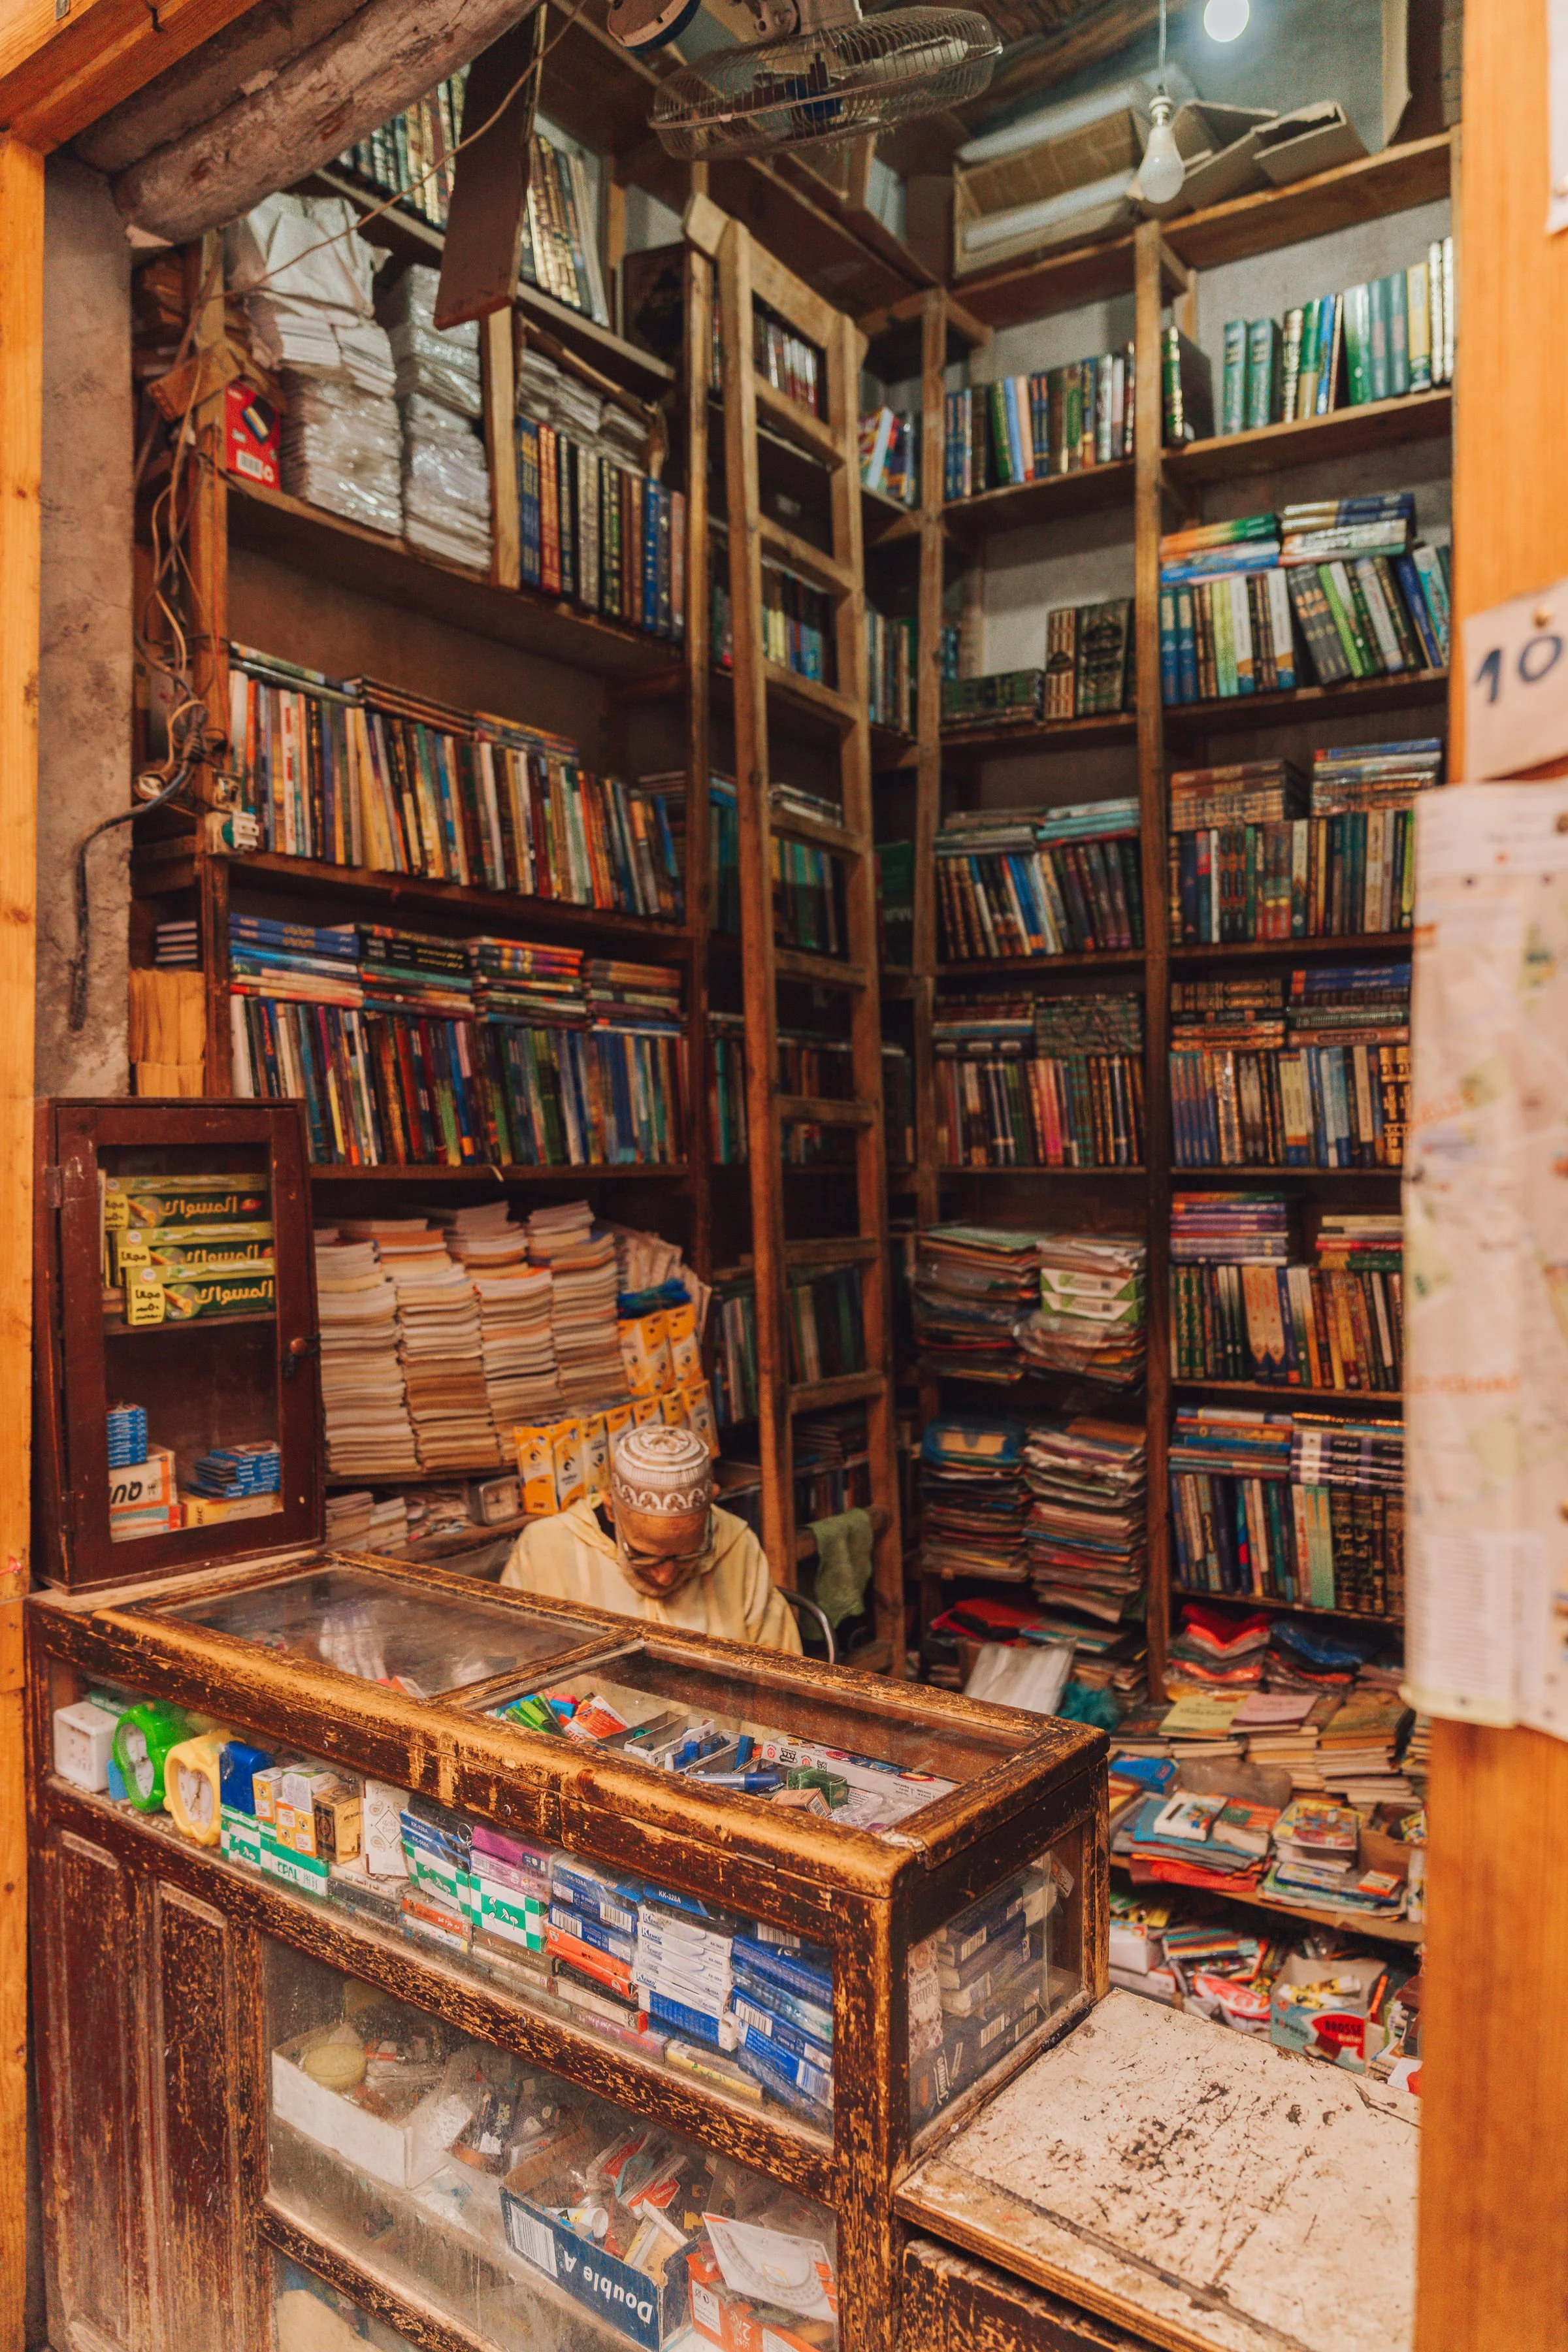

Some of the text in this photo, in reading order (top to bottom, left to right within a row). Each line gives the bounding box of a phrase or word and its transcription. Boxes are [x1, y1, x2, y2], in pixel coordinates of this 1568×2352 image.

[1474, 634, 1563, 704] 10
[659, 1889, 681, 1904] KK-328A
[641, 1927, 662, 1942] KENKO
[636, 1971, 657, 1987] KENKO
[563, 2249, 578, 2274] A
[583, 2265, 653, 2325] Double
